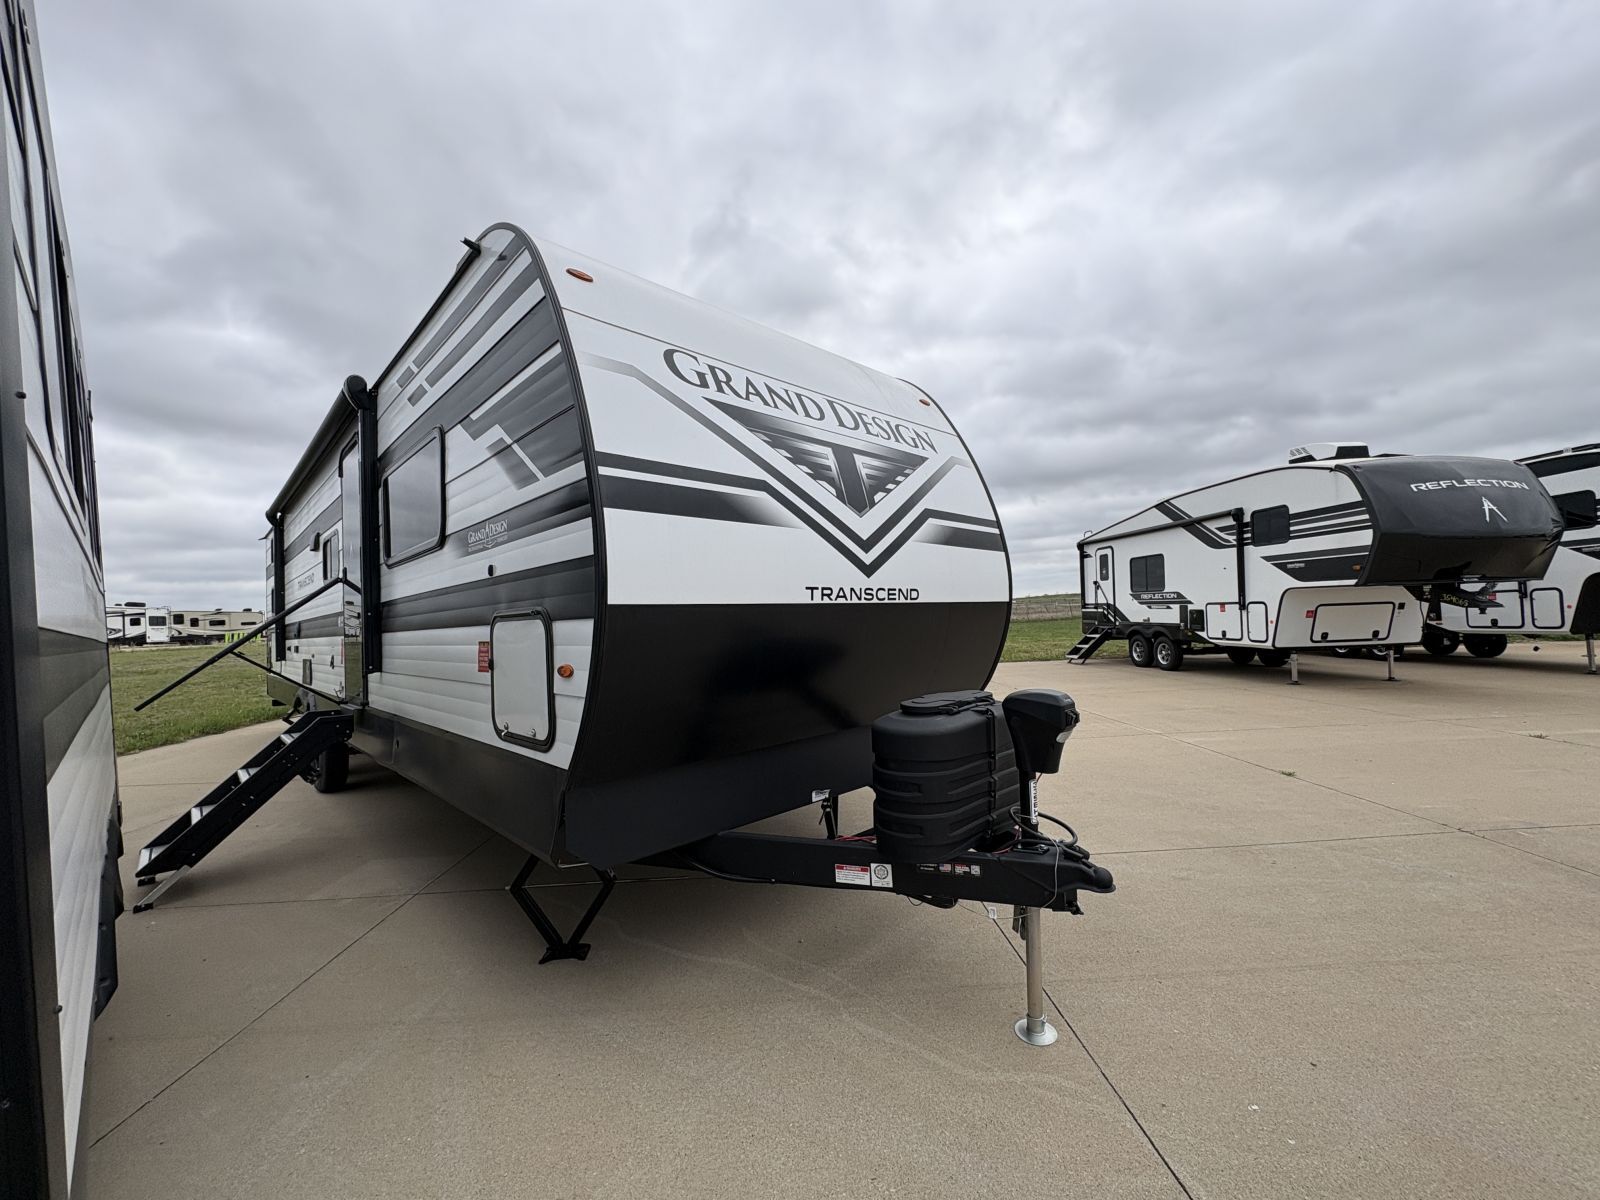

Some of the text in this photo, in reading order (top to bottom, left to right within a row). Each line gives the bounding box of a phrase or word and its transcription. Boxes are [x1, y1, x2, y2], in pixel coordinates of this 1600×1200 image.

[662, 348, 938, 454] GRAND DESIGN
[1409, 478, 1530, 492] REFLECTION
[805, 586, 920, 602] TRANSCEND
